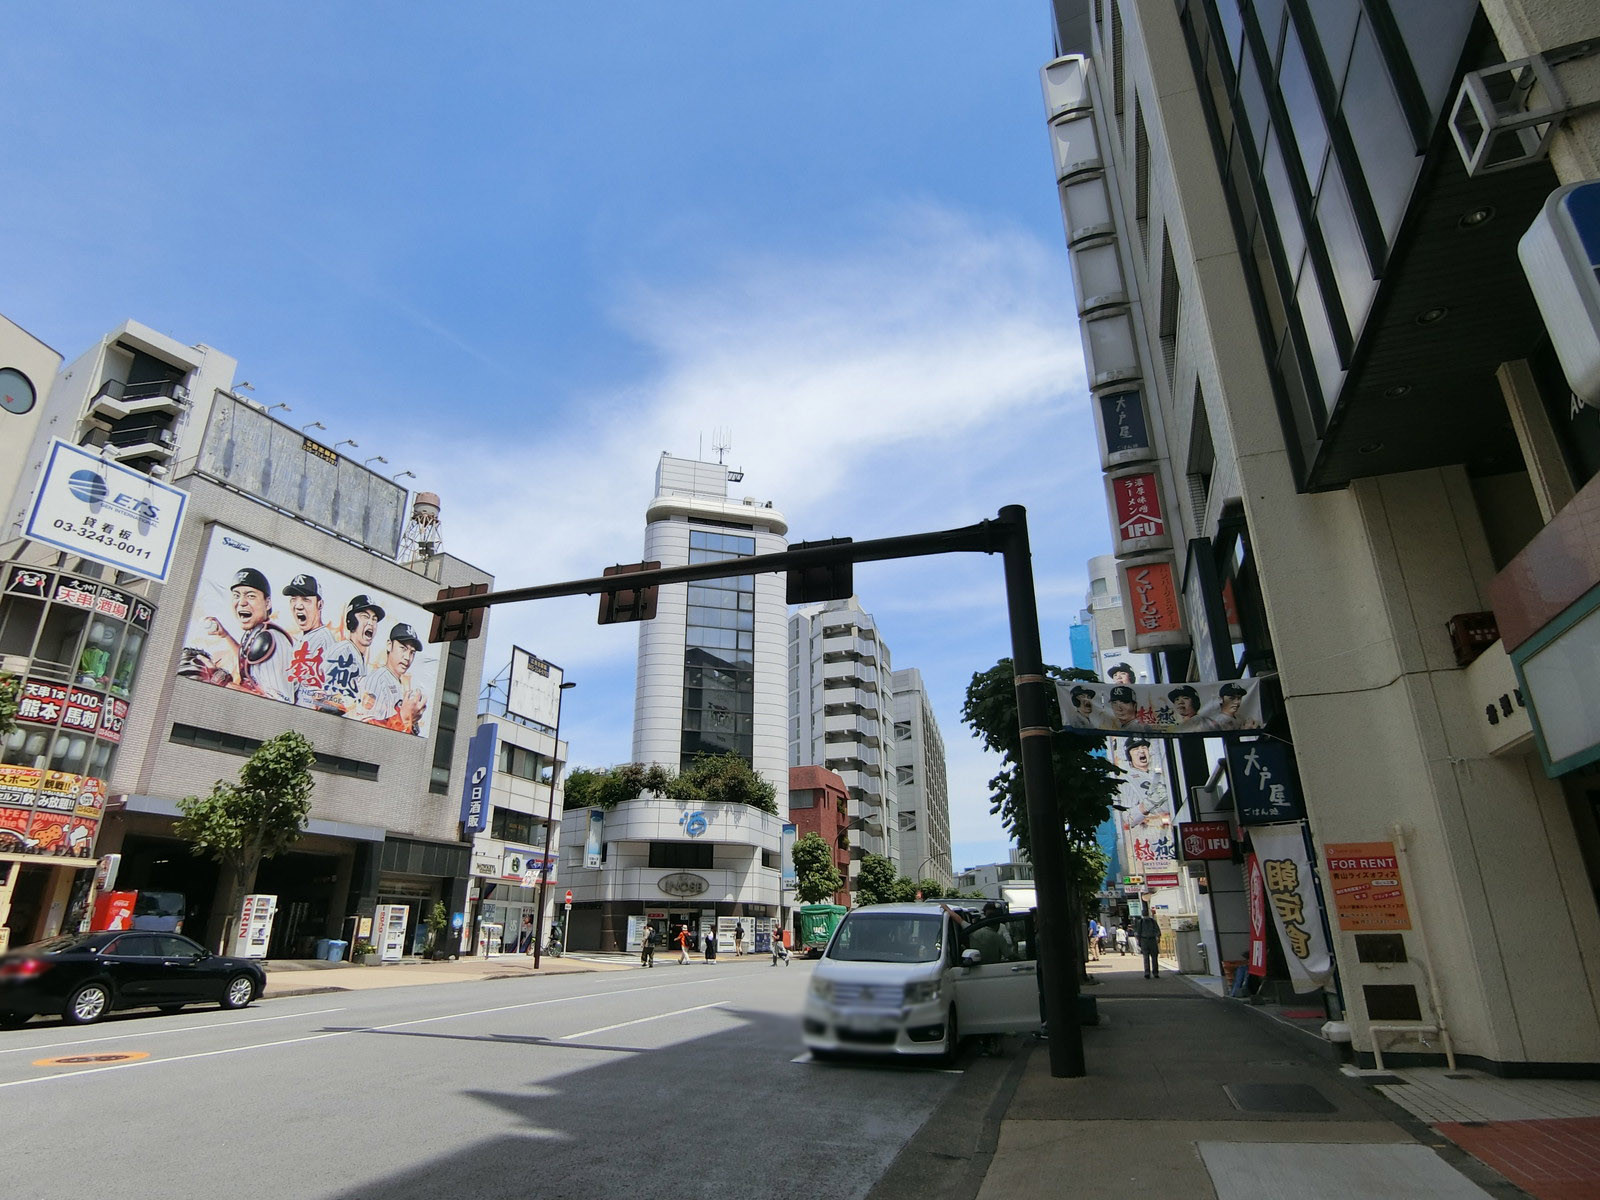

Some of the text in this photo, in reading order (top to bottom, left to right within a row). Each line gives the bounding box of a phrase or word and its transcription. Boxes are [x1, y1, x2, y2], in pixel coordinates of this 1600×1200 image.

[1115, 396, 1133, 439] 大戸屋
[1124, 480, 1138, 515] ラーメン
[53, 519, 152, 560] 03-3243-0011
[82, 516, 133, 541] 貸看板
[1128, 521, 1156, 538] IFU
[58, 587, 127, 617] 天串 酒場
[69, 580, 96, 594] 九州
[19, 698, 61, 720] 熊本
[64, 706, 98, 729] 馬刺
[1244, 747, 1292, 807] 大戸屋
[467, 786, 482, 828] 日酒販
[1243, 807, 1280, 816] ごはん処
[1208, 838, 1230, 849] IFU
[1330, 858, 1394, 870] FOR RENT
[239, 897, 254, 938] KIRIN
